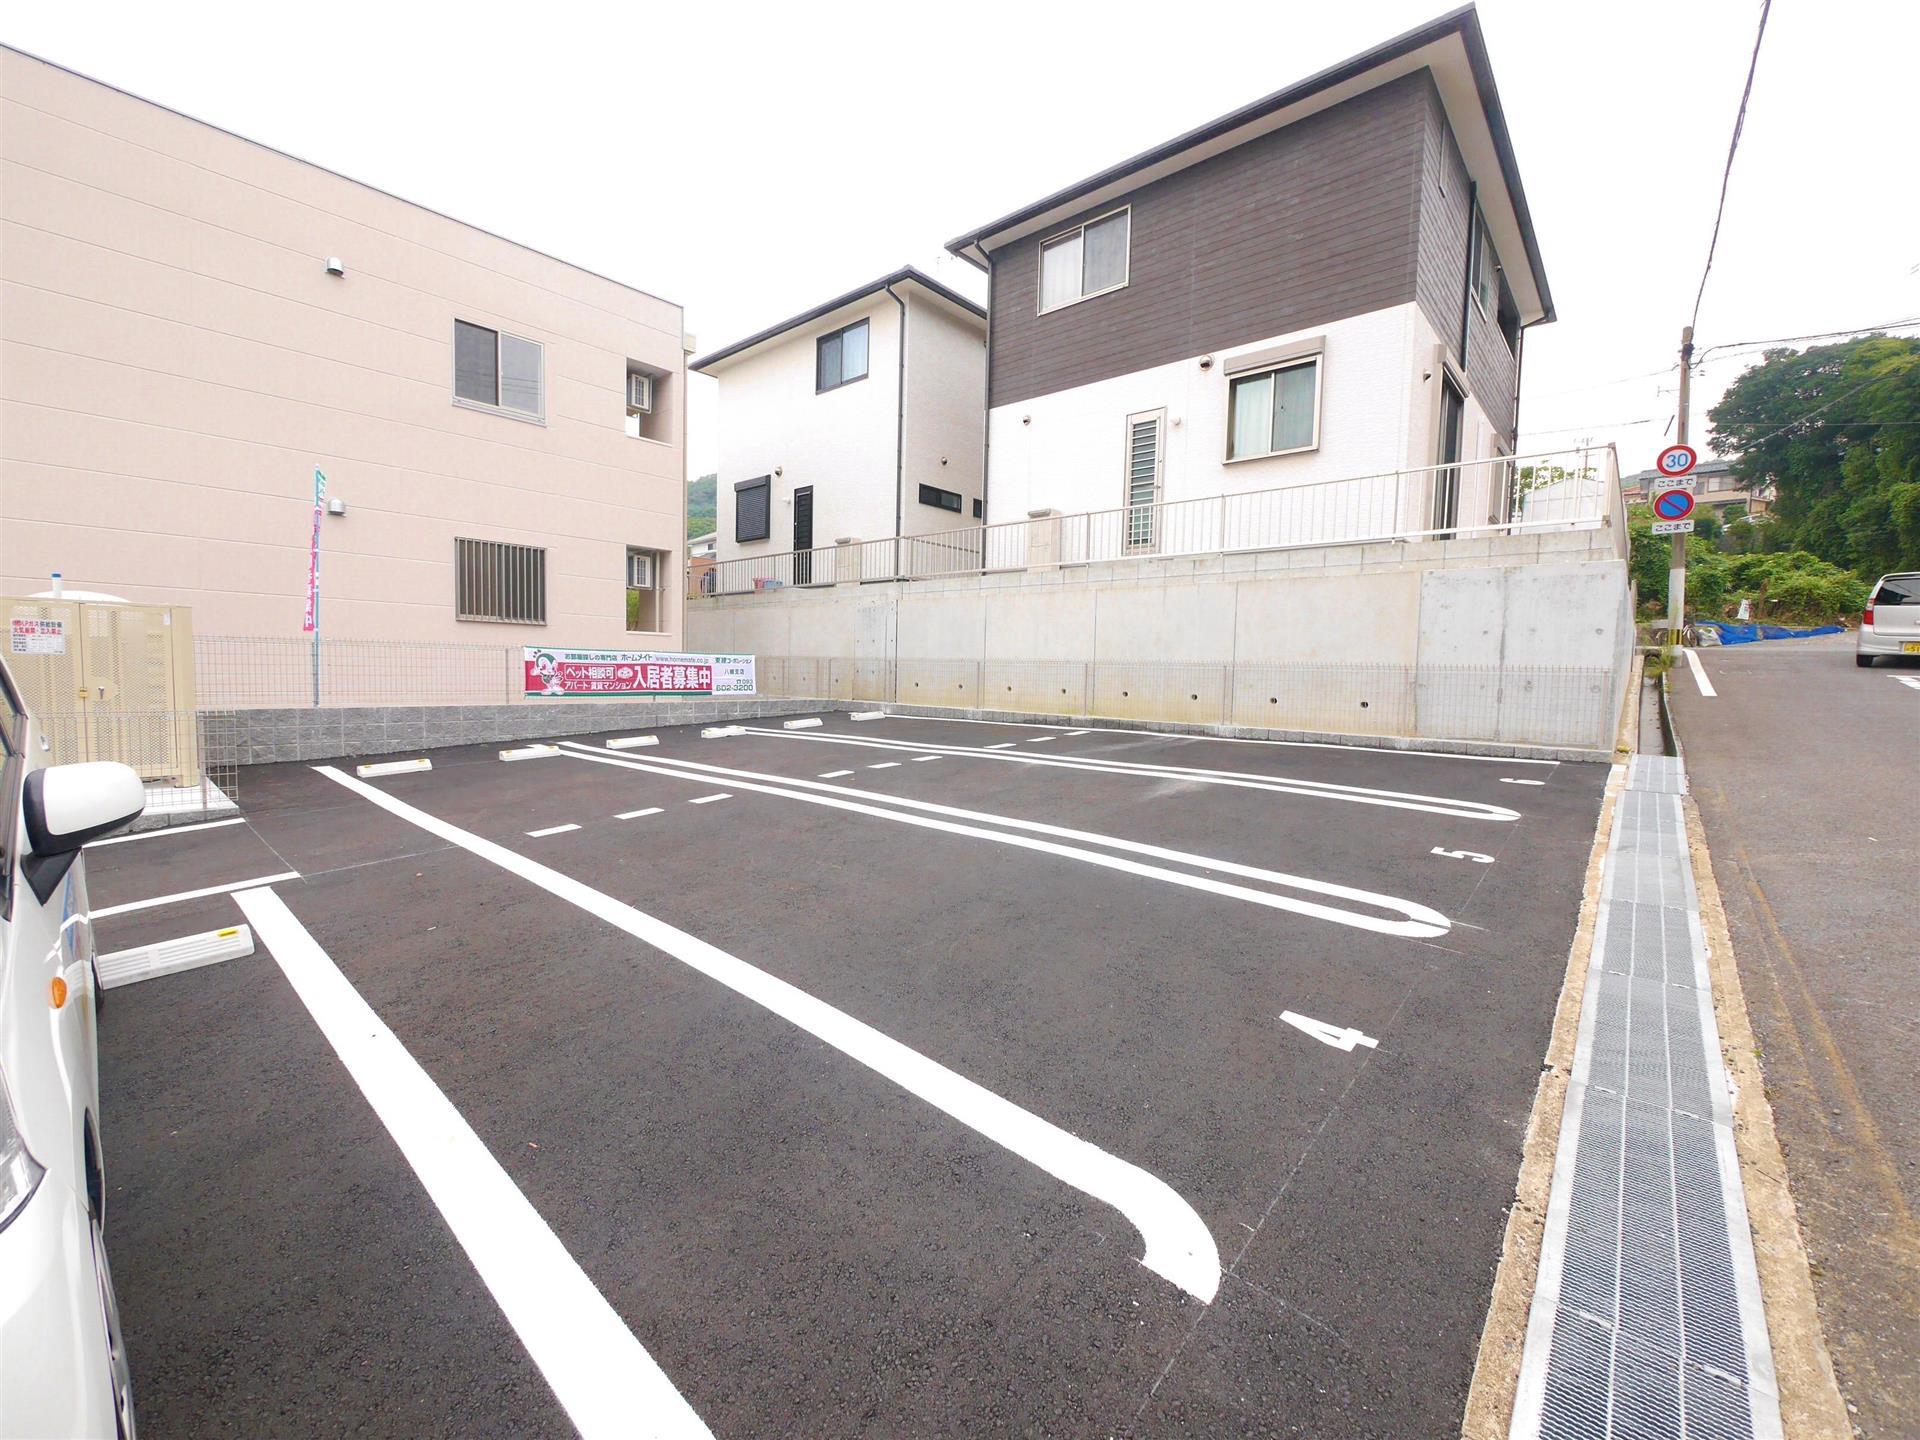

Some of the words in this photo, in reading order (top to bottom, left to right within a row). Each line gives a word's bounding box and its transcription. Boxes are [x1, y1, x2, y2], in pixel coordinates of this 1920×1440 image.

[1666, 453, 1688, 468] 30
[1657, 478, 1693, 488] ここまで
[1655, 522, 1691, 532] ここまで
[564, 653, 617, 661] お部屋探しの専門店
[621, 653, 653, 662] ホームメイト
[655, 655, 709, 664] www.homemate.co.jp
[566, 666, 615, 679] ペット相談可
[632, 665, 711, 689] 入居者募集中
[716, 684, 754, 692] 602-3200
[1430, 846, 1496, 864] 5
[1279, 1010, 1380, 1052] 4
